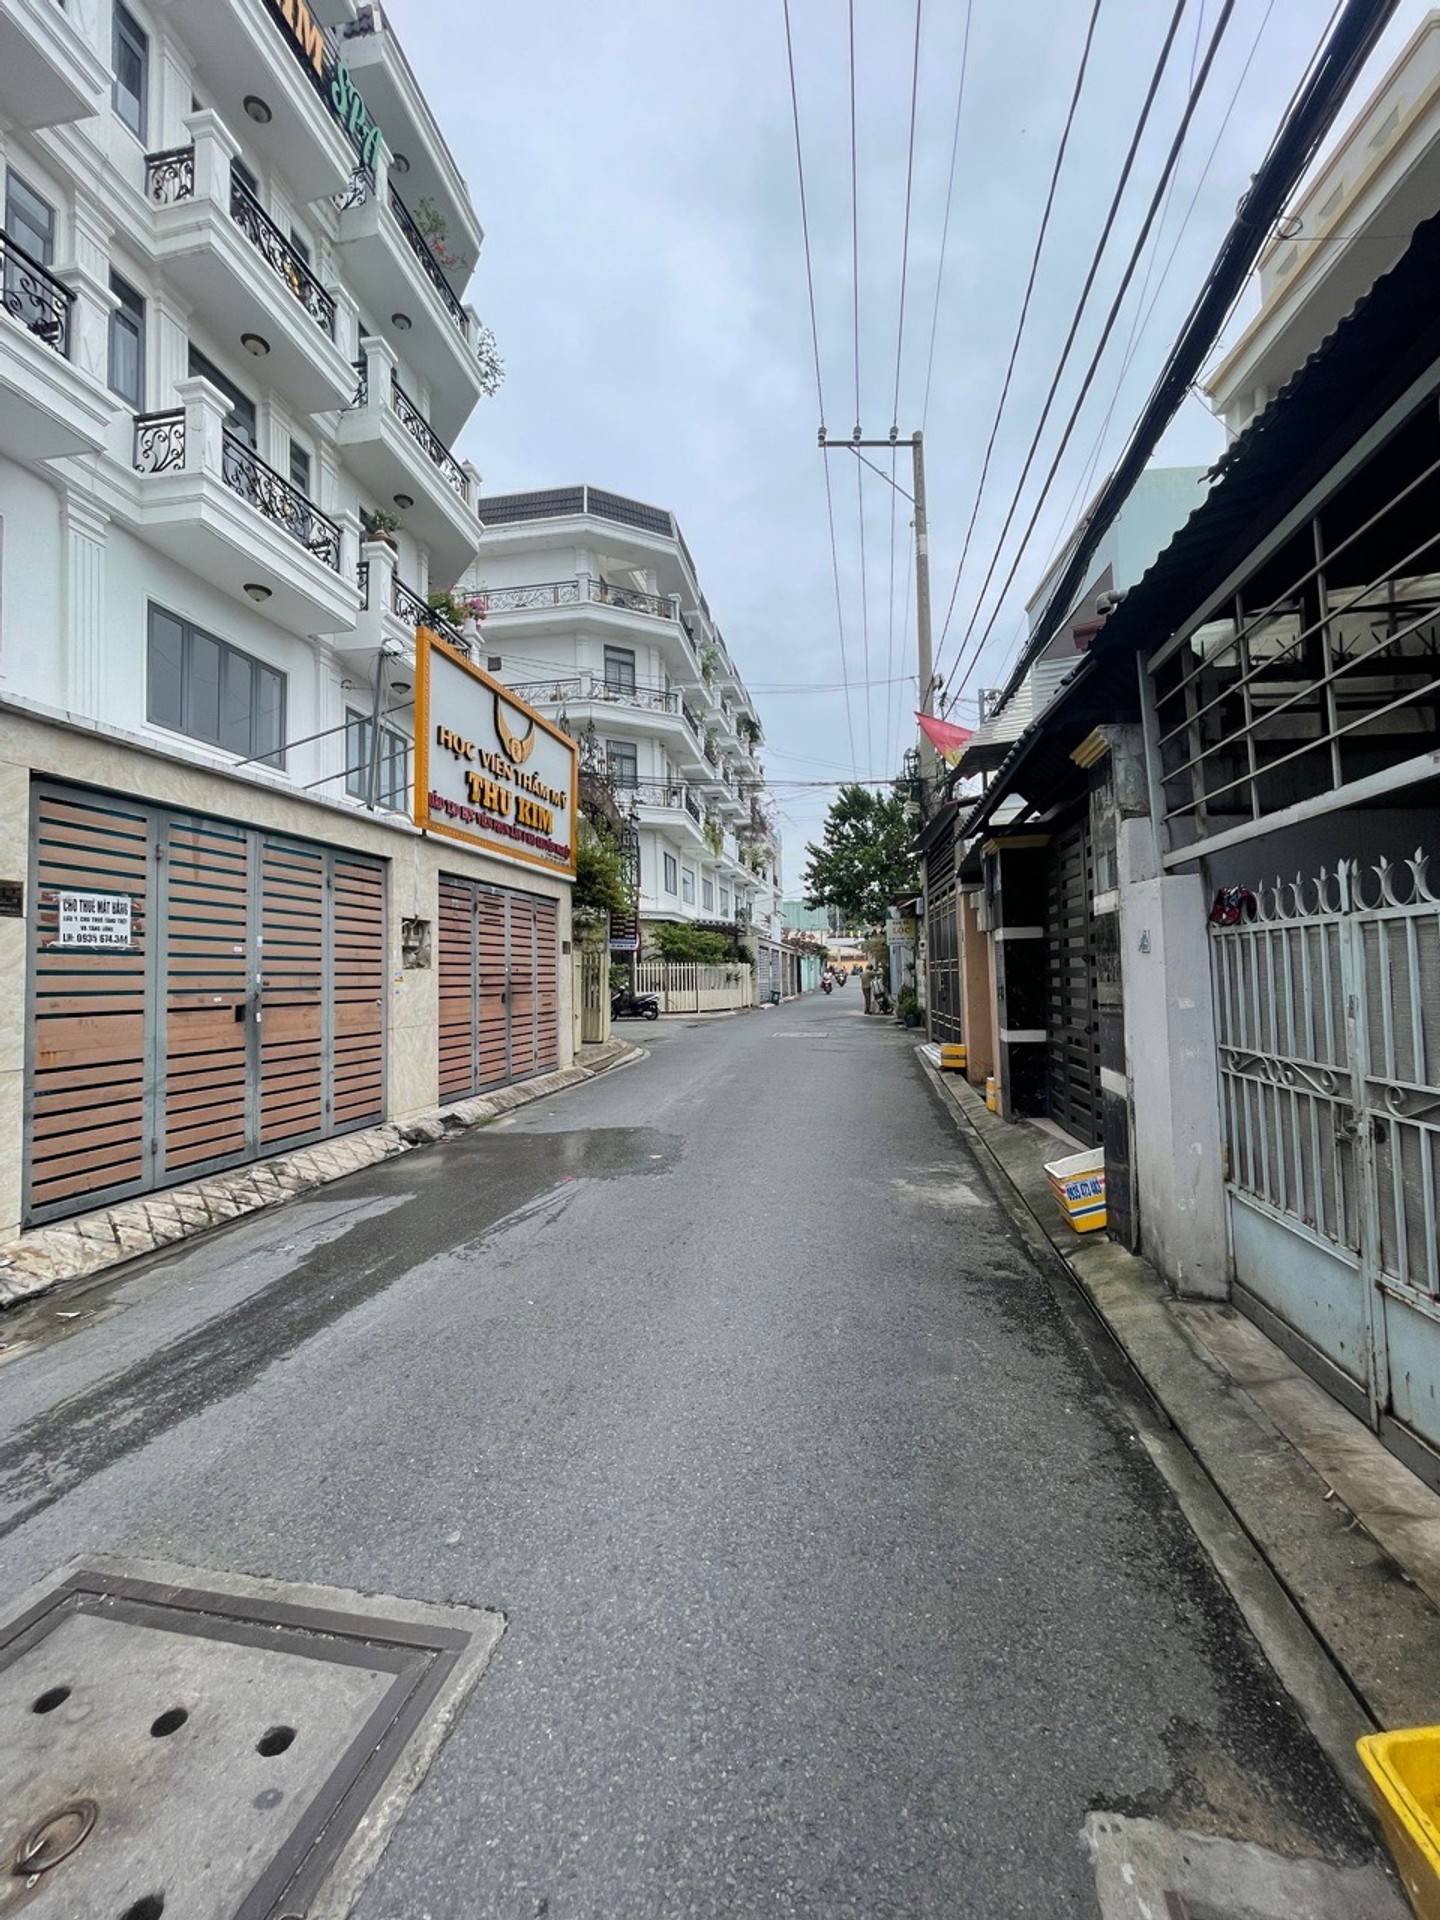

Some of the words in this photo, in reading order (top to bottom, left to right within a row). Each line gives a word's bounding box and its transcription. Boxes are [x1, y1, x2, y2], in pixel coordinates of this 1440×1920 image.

[437, 725, 475, 761] HỌC
[478, 749, 514, 780] VIỆN
[513, 768, 550, 800] THẨM
[465, 770, 512, 817] THU
[515, 796, 553, 834] KIM
[63, 899, 77, 912] CHO
